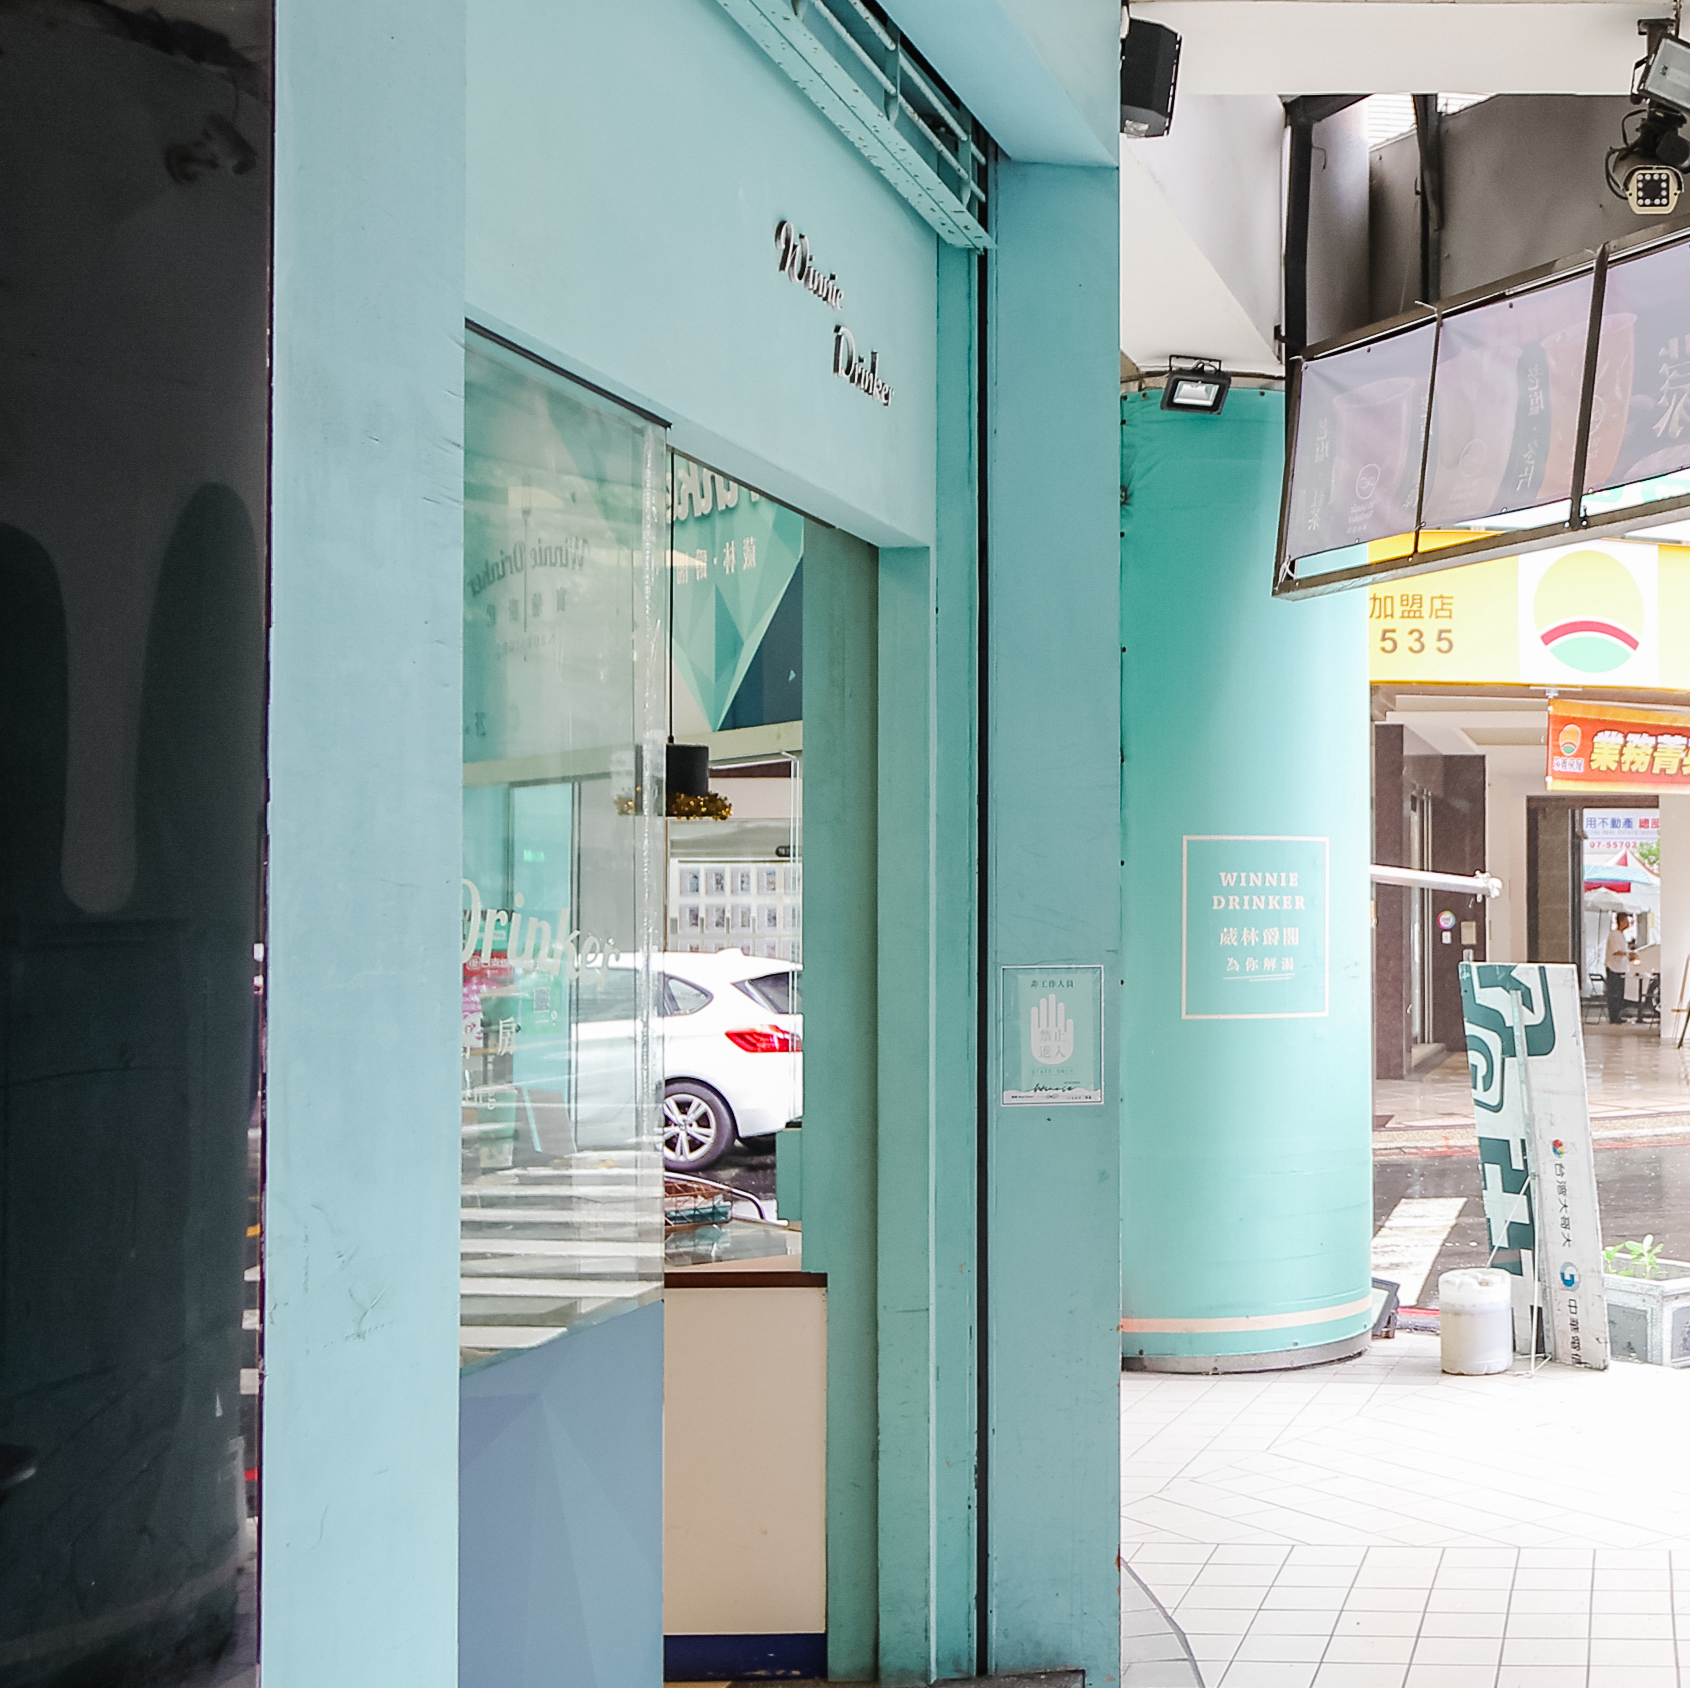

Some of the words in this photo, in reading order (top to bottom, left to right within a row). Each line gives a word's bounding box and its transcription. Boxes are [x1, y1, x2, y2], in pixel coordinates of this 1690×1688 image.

[774, 219, 845, 310] Winnie
[832, 324, 896, 406] Drinker
[1369, 593, 1454, 620] 加盟店
[1379, 627, 1454, 654] 535
[1585, 817, 1633, 829] 用不動產
[1219, 871, 1299, 887] WINNIE
[1212, 895, 1306, 910] DRINKER
